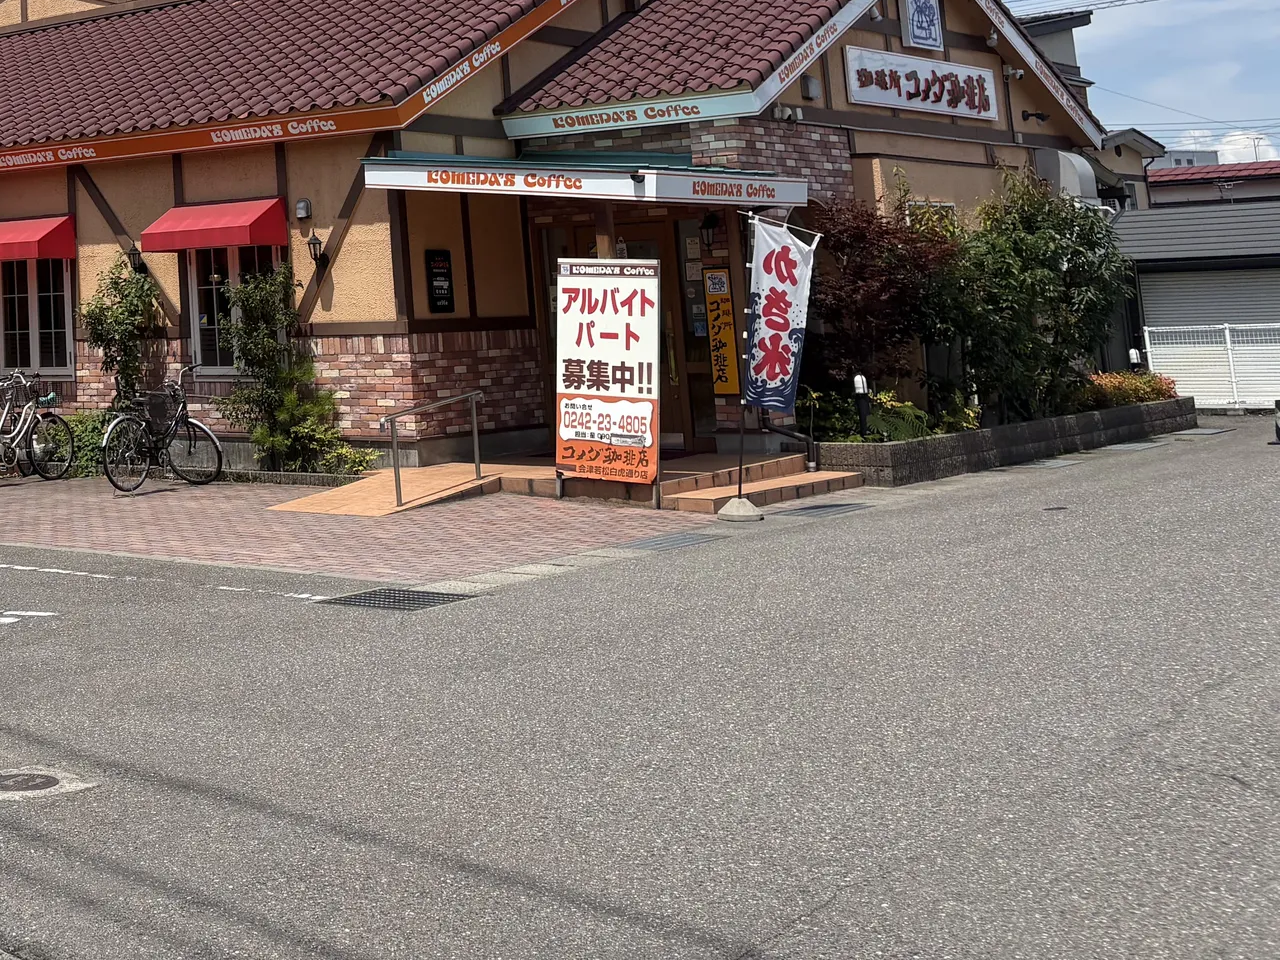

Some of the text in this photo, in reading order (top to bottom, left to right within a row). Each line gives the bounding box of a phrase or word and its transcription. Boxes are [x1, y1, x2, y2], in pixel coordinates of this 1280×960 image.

[778, 22, 838, 85] KOMEDA'S Coffee
[422, 41, 501, 104] KOMEDA'S Coffee
[551, 103, 701, 129] KOMEDA'S Coffee
[211, 119, 337, 144] KOMEDA'S Coffee
[57, 147, 97, 161] Coffee
[427, 169, 583, 191] KOMEDA'S Coffee
[692, 180, 776, 199] KOMEDA'S Coffee
[572, 265, 655, 276] KOMEDA'S Coffee
[562, 287, 655, 317] アルバイト
[575, 320, 640, 351] パート
[562, 358, 653, 395] 募集中!!
[563, 411, 647, 434] 0242-23-4805
[561, 445, 649, 468] コメダ珈琲店
[578, 464, 649, 479] 会津若松白虎通り店
